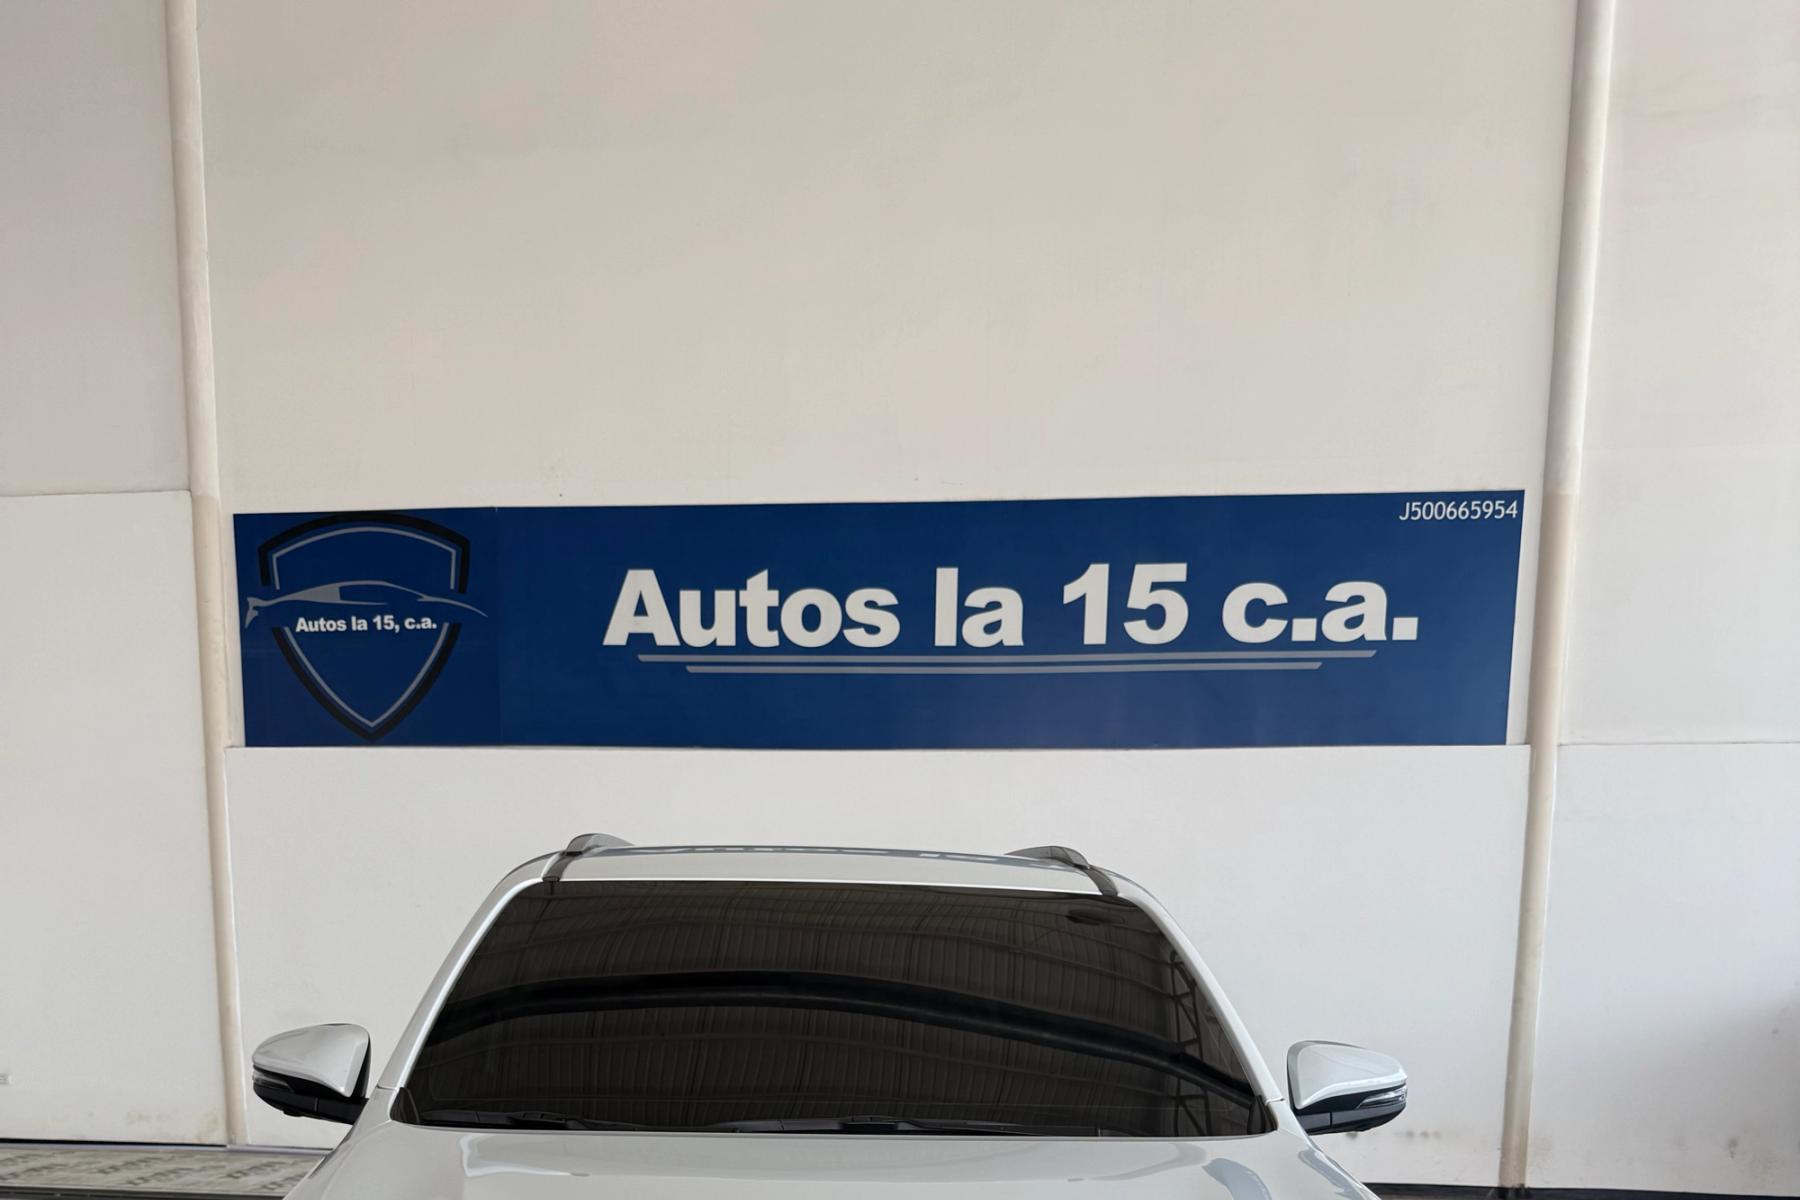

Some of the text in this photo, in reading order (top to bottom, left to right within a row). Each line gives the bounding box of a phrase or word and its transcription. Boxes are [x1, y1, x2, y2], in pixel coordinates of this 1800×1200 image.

[1399, 501, 1518, 520] J500665954
[603, 563, 1419, 648] Autos la 15 c.a.
[295, 615, 437, 633] Autos la 15, c.a.
